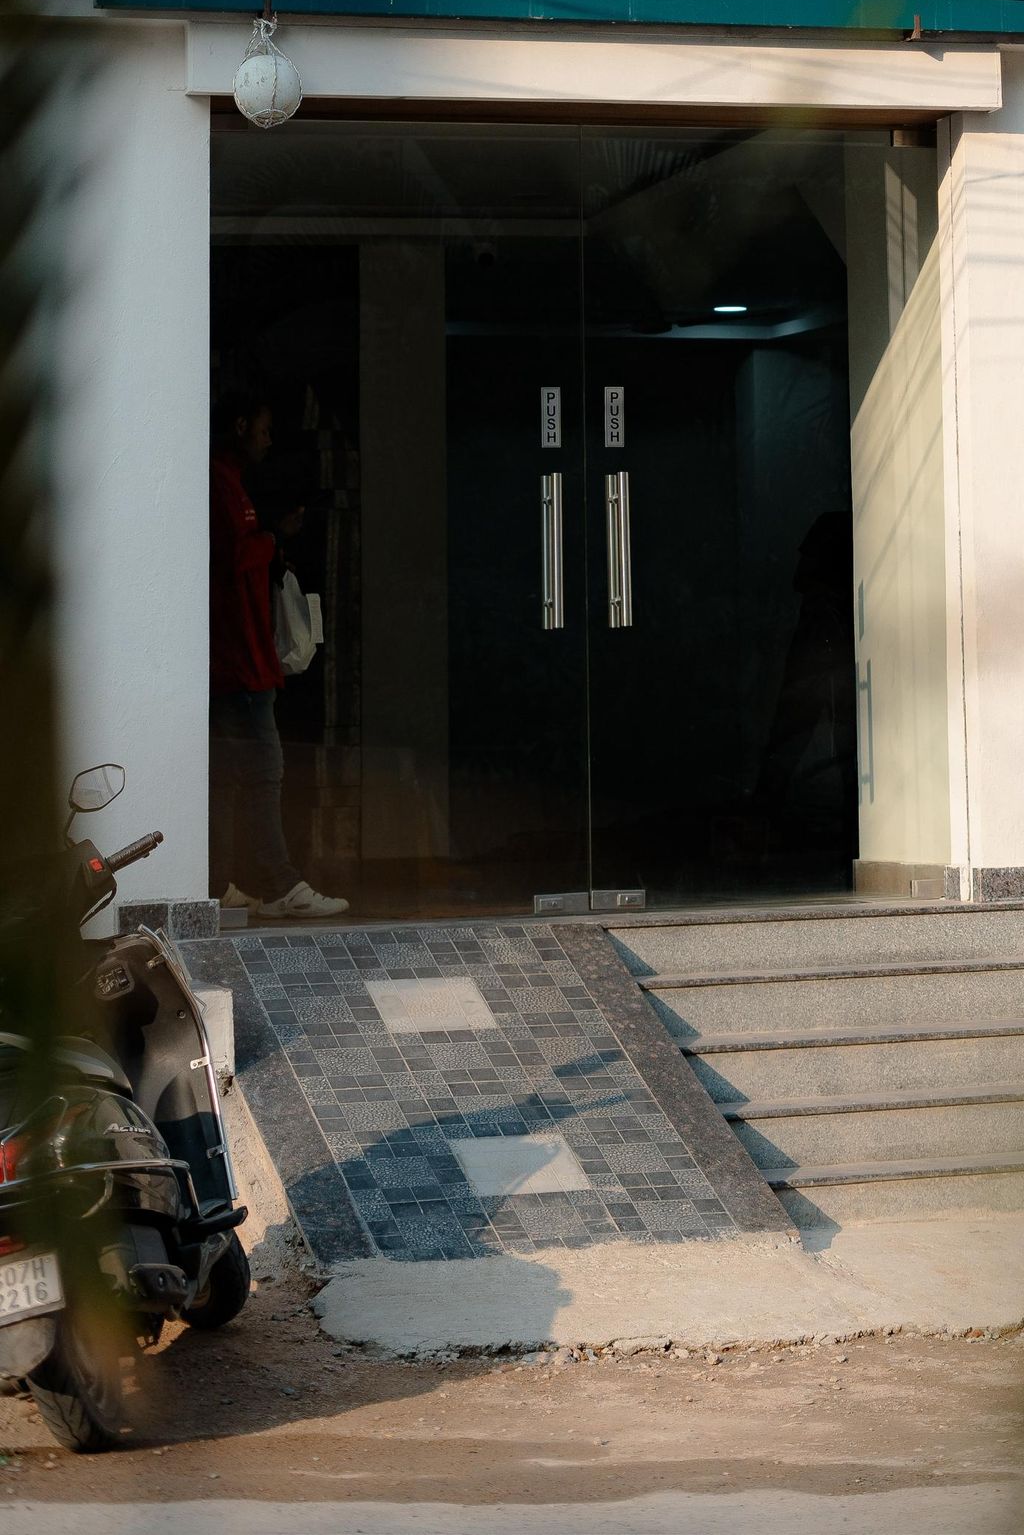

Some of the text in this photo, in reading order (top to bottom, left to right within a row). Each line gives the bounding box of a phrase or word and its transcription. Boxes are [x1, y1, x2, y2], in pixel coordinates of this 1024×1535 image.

[546, 392, 557, 443] PUSH
[610, 391, 620, 442] PUSH
[0, 1257, 45, 1288] 07H
